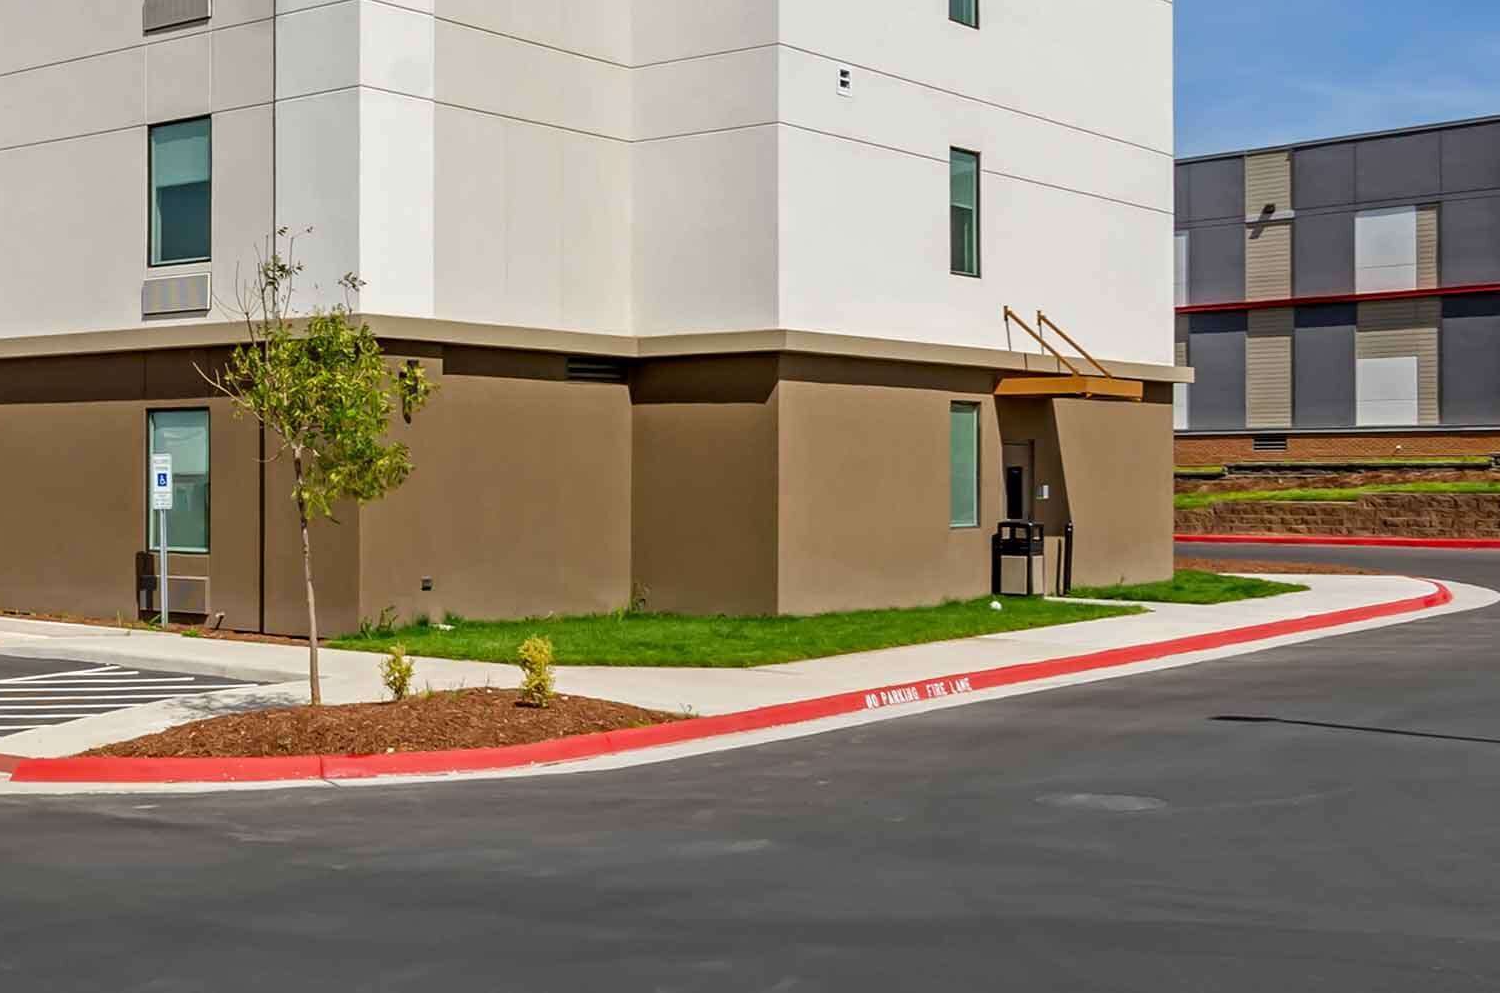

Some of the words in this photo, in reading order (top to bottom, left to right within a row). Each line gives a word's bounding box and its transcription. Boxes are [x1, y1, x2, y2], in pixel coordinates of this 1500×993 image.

[865, 694, 879, 710] NO
[881, 687, 920, 706] PARKING
[926, 681, 948, 698] FIRE
[949, 678, 972, 694] LANE
